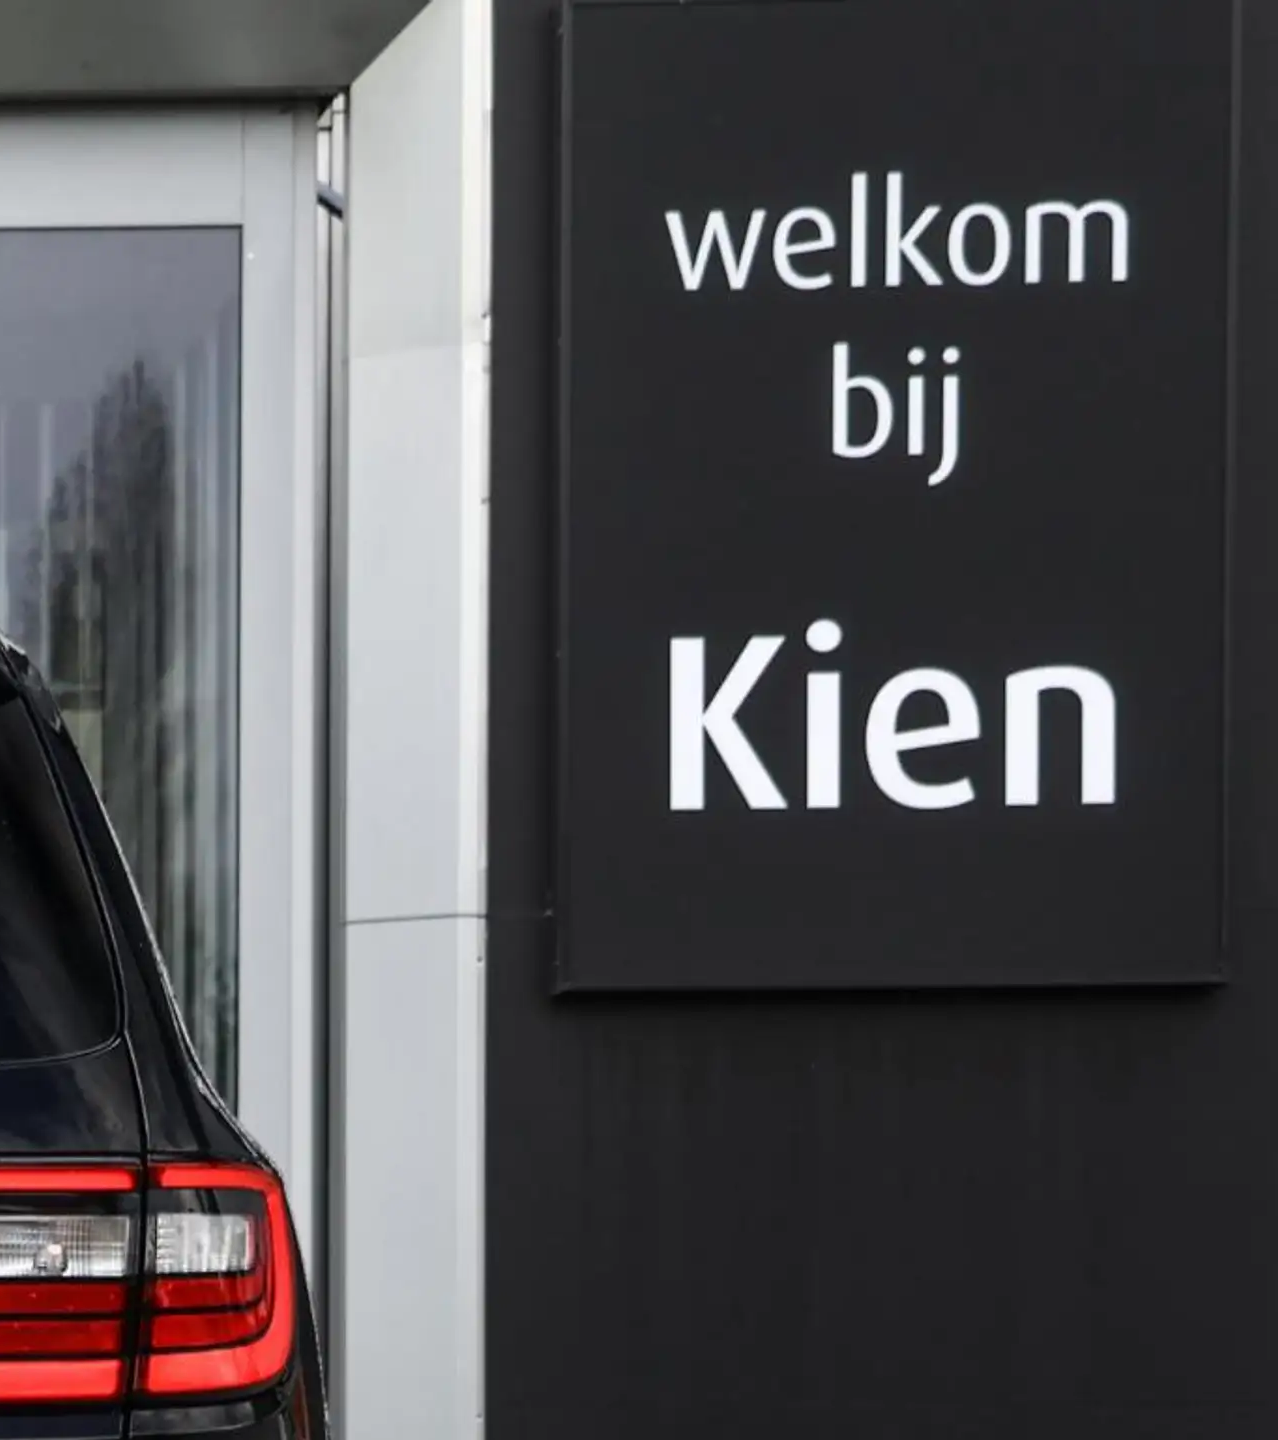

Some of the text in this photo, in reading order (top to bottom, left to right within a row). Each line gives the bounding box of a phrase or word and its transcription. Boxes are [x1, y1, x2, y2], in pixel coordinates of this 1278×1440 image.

[664, 171, 1130, 291] welkom
[831, 341, 961, 486] bij
[669, 618, 1117, 811] Kien
